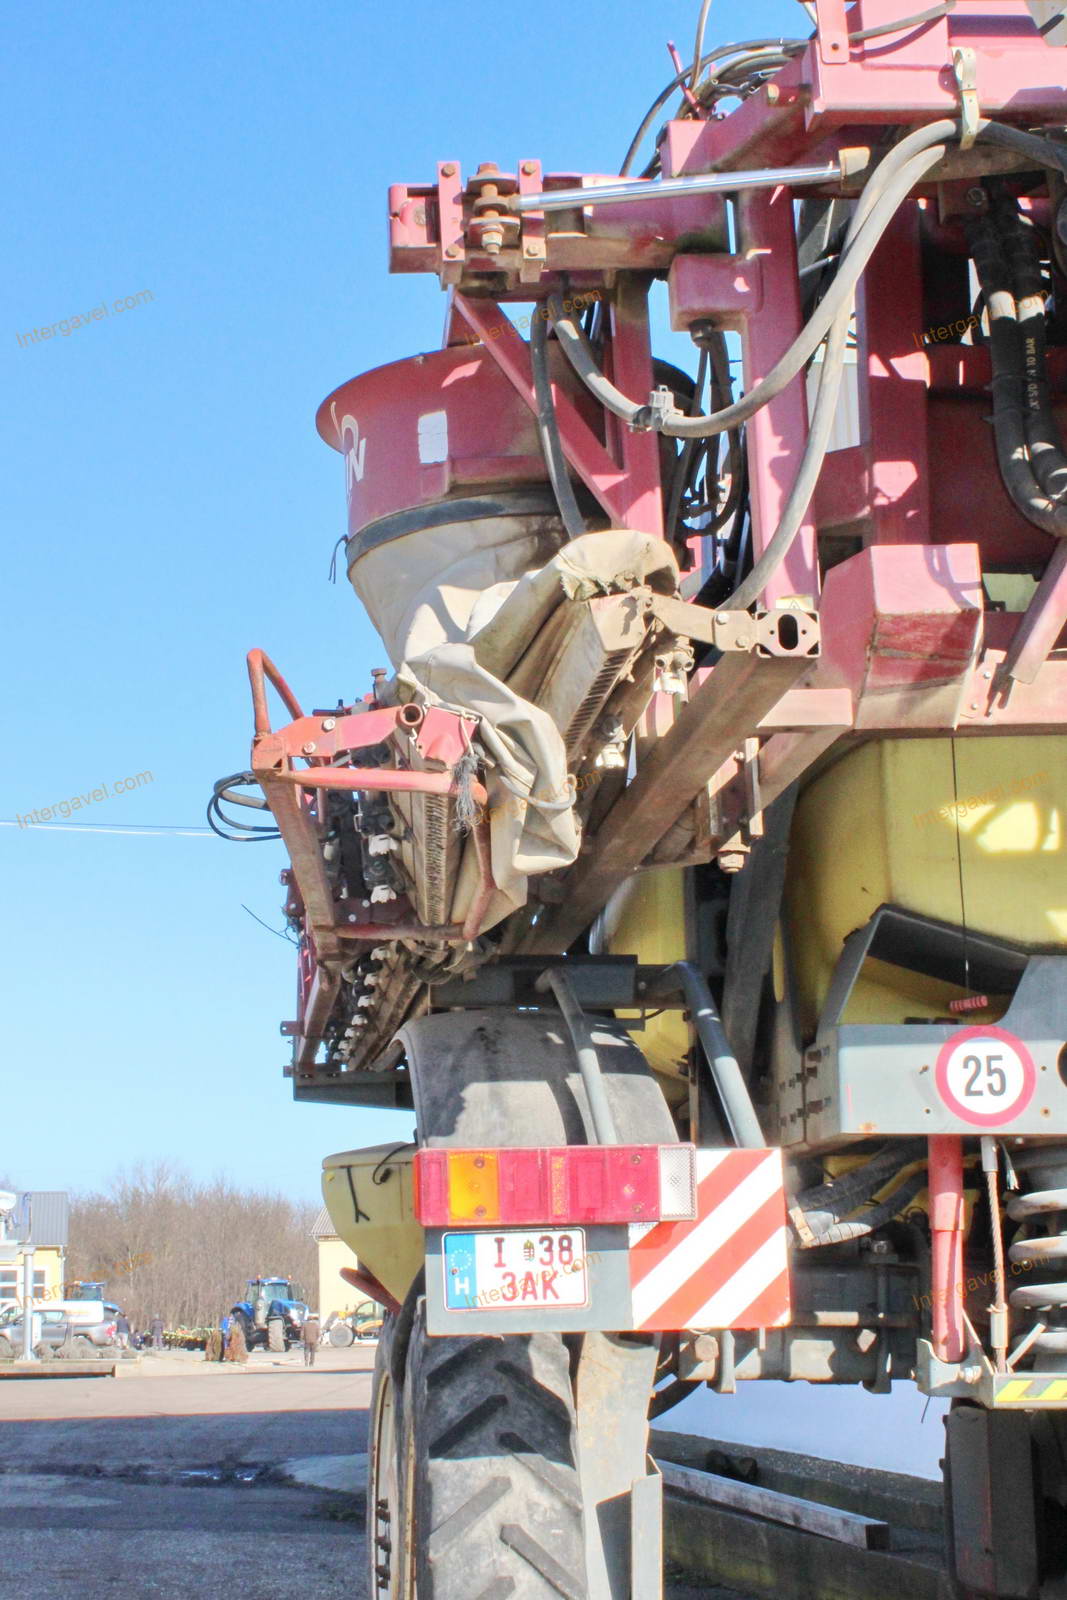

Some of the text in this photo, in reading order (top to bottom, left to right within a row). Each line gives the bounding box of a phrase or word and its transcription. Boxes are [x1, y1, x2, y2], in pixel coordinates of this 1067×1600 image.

[962, 1055, 1007, 1096] 25
[538, 1234, 574, 1266] 38
[455, 1277, 470, 1295] H
[502, 1270, 560, 1301] 3AK
